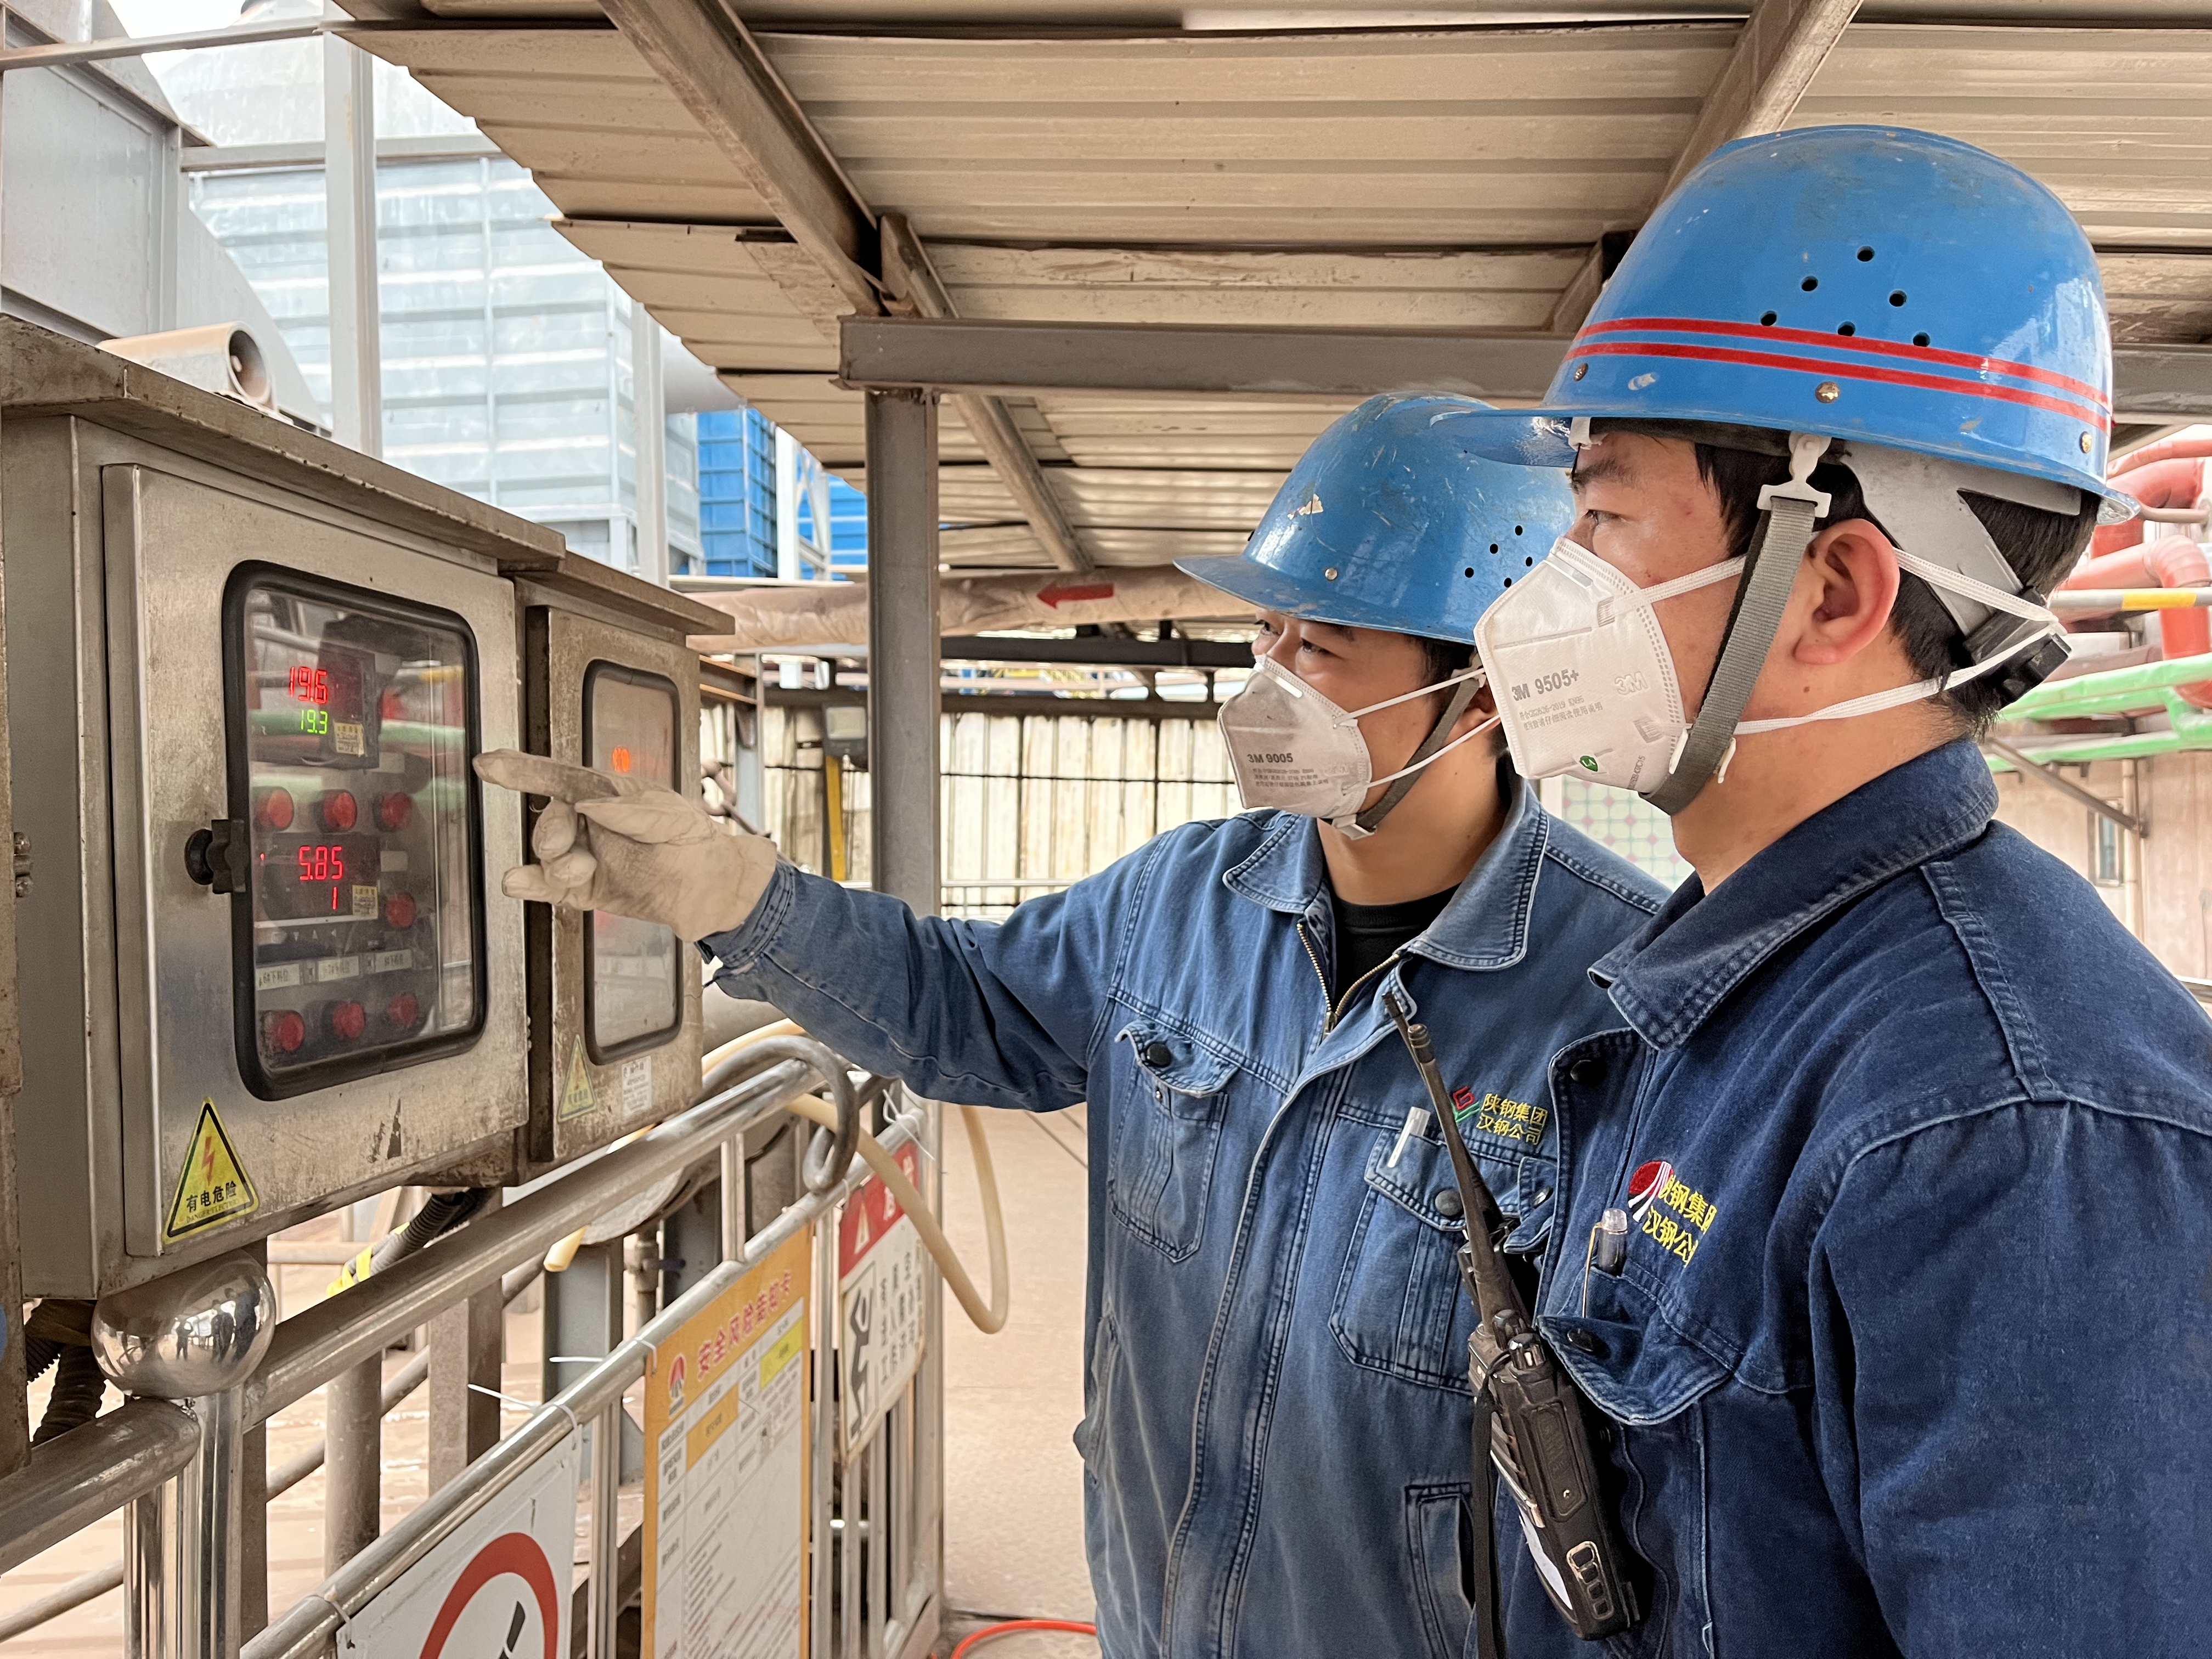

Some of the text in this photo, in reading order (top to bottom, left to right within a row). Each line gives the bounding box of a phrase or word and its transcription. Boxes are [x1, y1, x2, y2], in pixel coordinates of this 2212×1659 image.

[289, 666, 328, 704] 19.6
[1511, 669, 1579, 701] 3M 9505+
[1614, 670, 1649, 696] 3M
[301, 709, 328, 734] 19.3
[1246, 753, 1294, 763] 3M 9005
[299, 845, 343, 880] 5.85
[1481, 1093, 1548, 1126] 陕钢集团
[1476, 1112, 1542, 1146] 汉钢公司
[186, 1180, 236, 1213] 有电危险
[1642, 1205, 1699, 1268] 汉钢公
